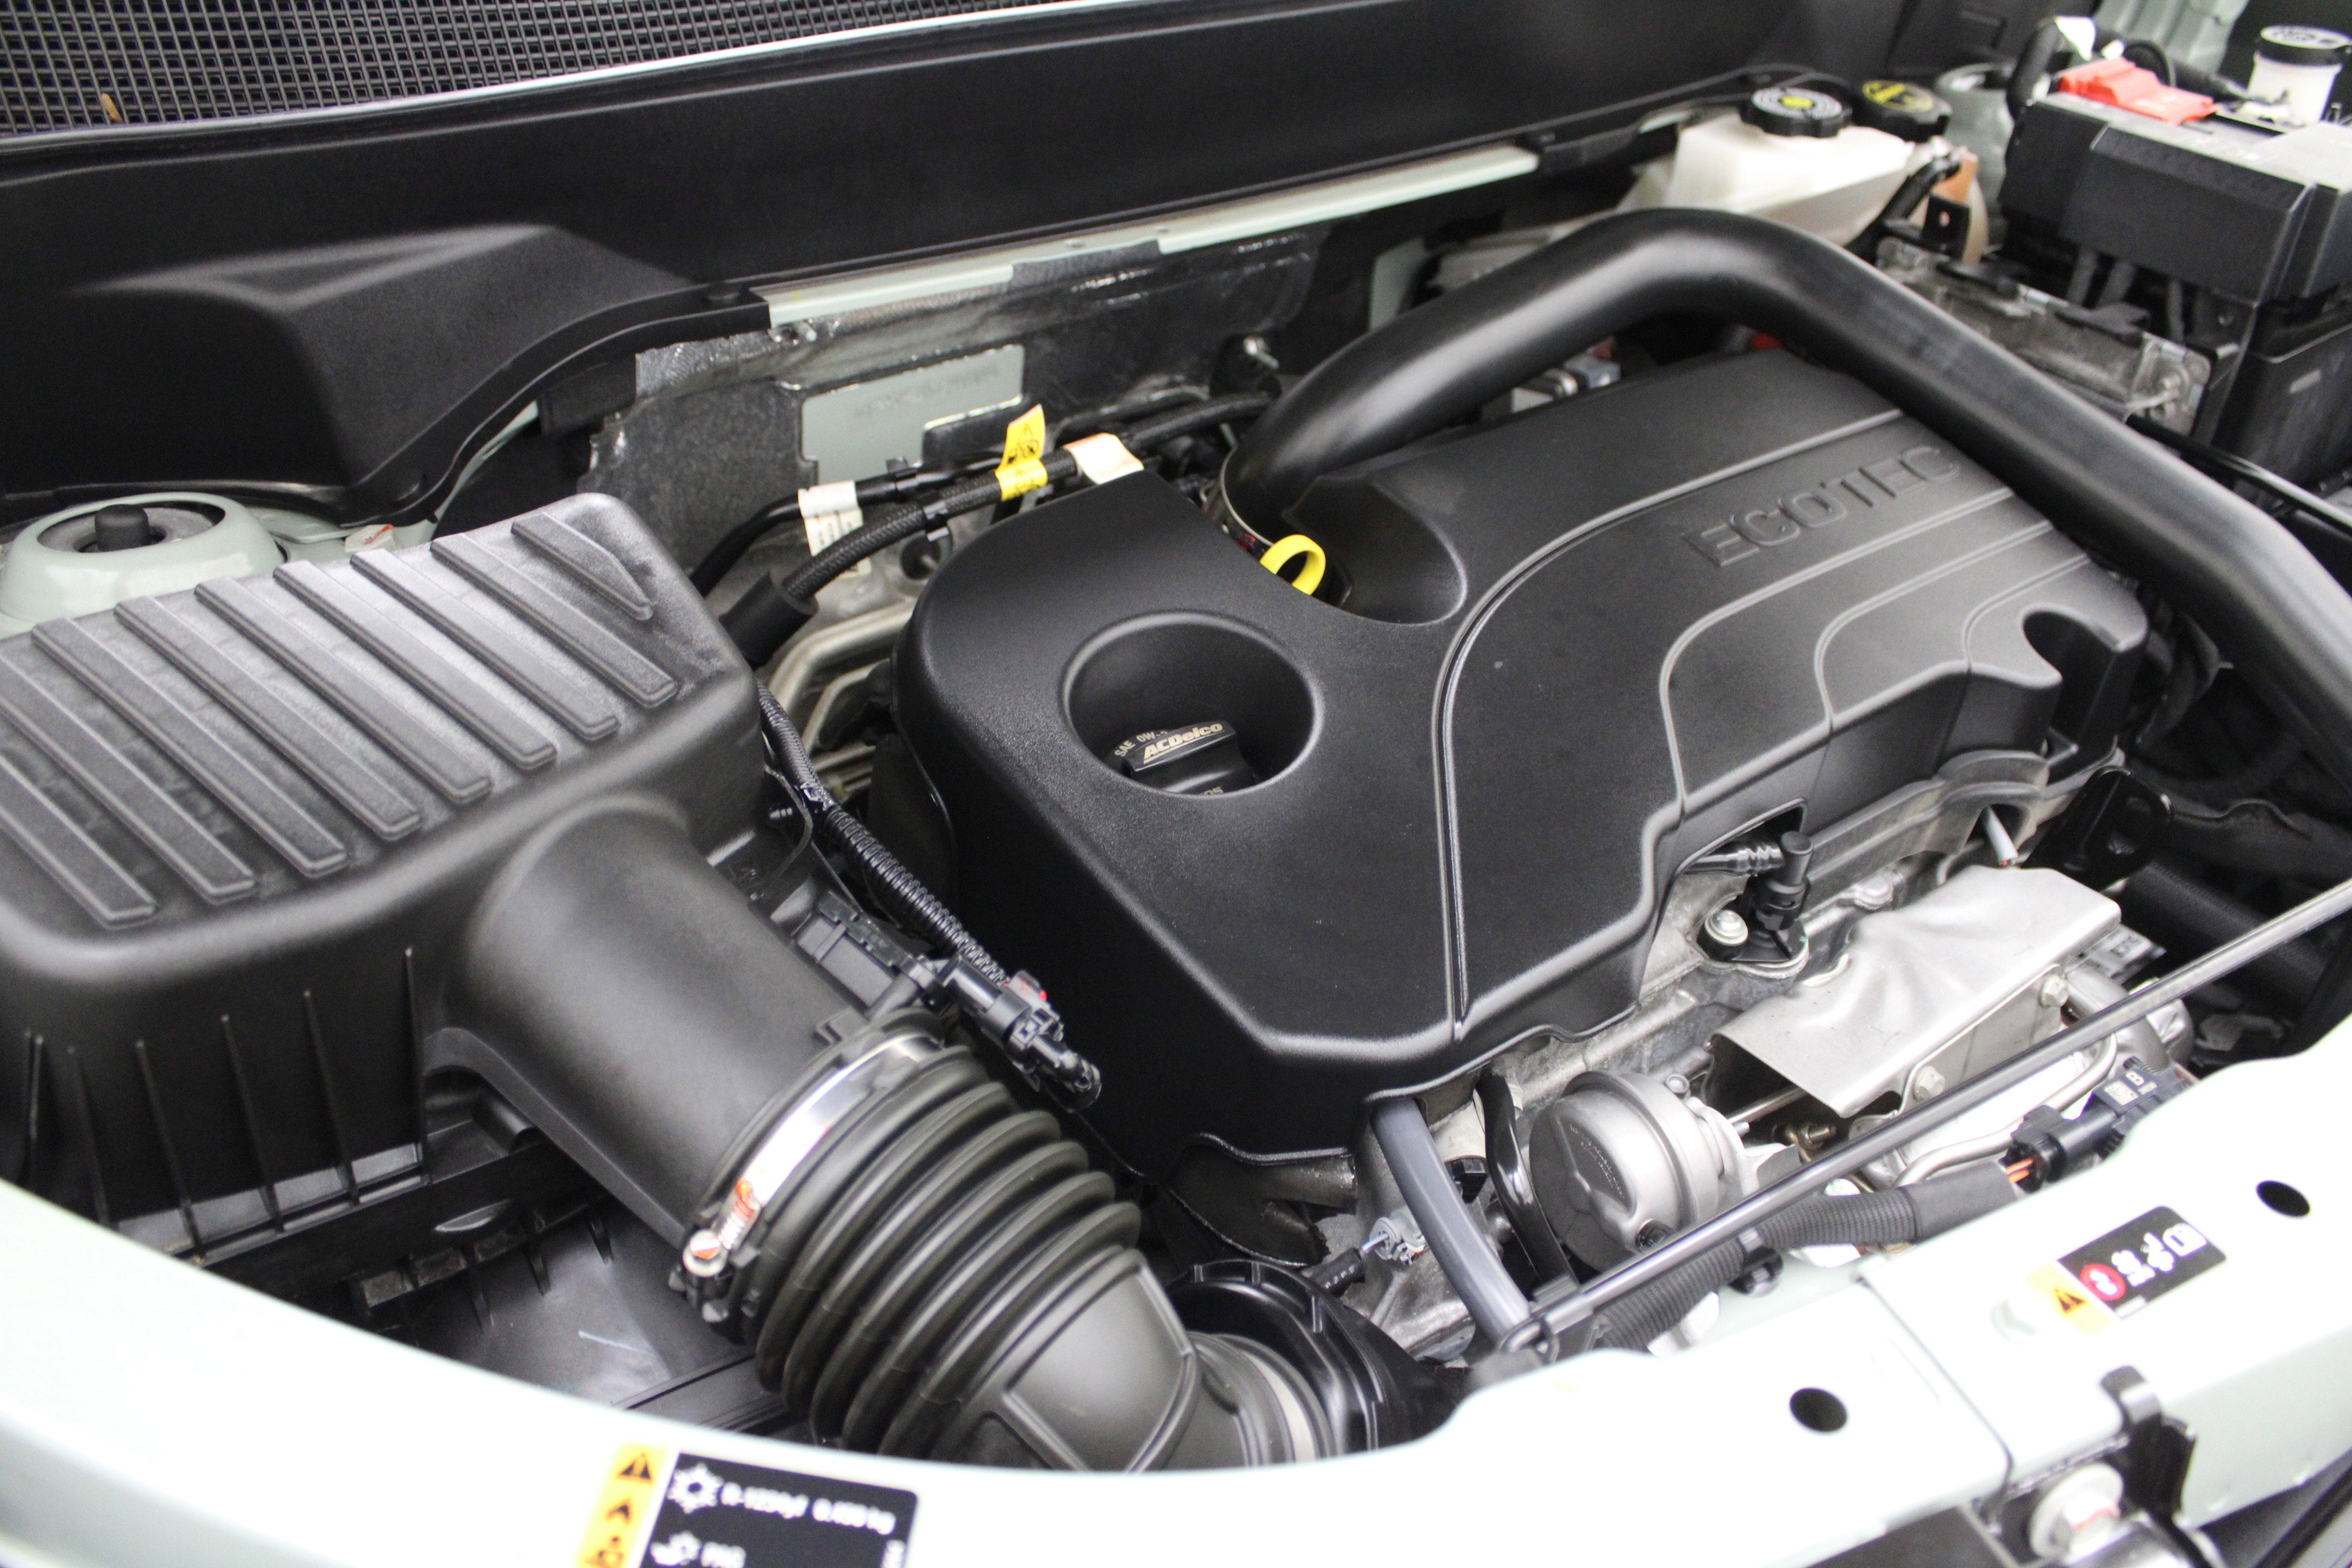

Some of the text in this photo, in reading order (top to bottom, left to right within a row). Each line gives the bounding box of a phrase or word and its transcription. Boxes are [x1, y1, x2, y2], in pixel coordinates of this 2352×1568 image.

[1681, 445, 1960, 568] ECOTEC
[1114, 739, 1136, 757] SAE
[1144, 723, 1223, 760] ACDelco
